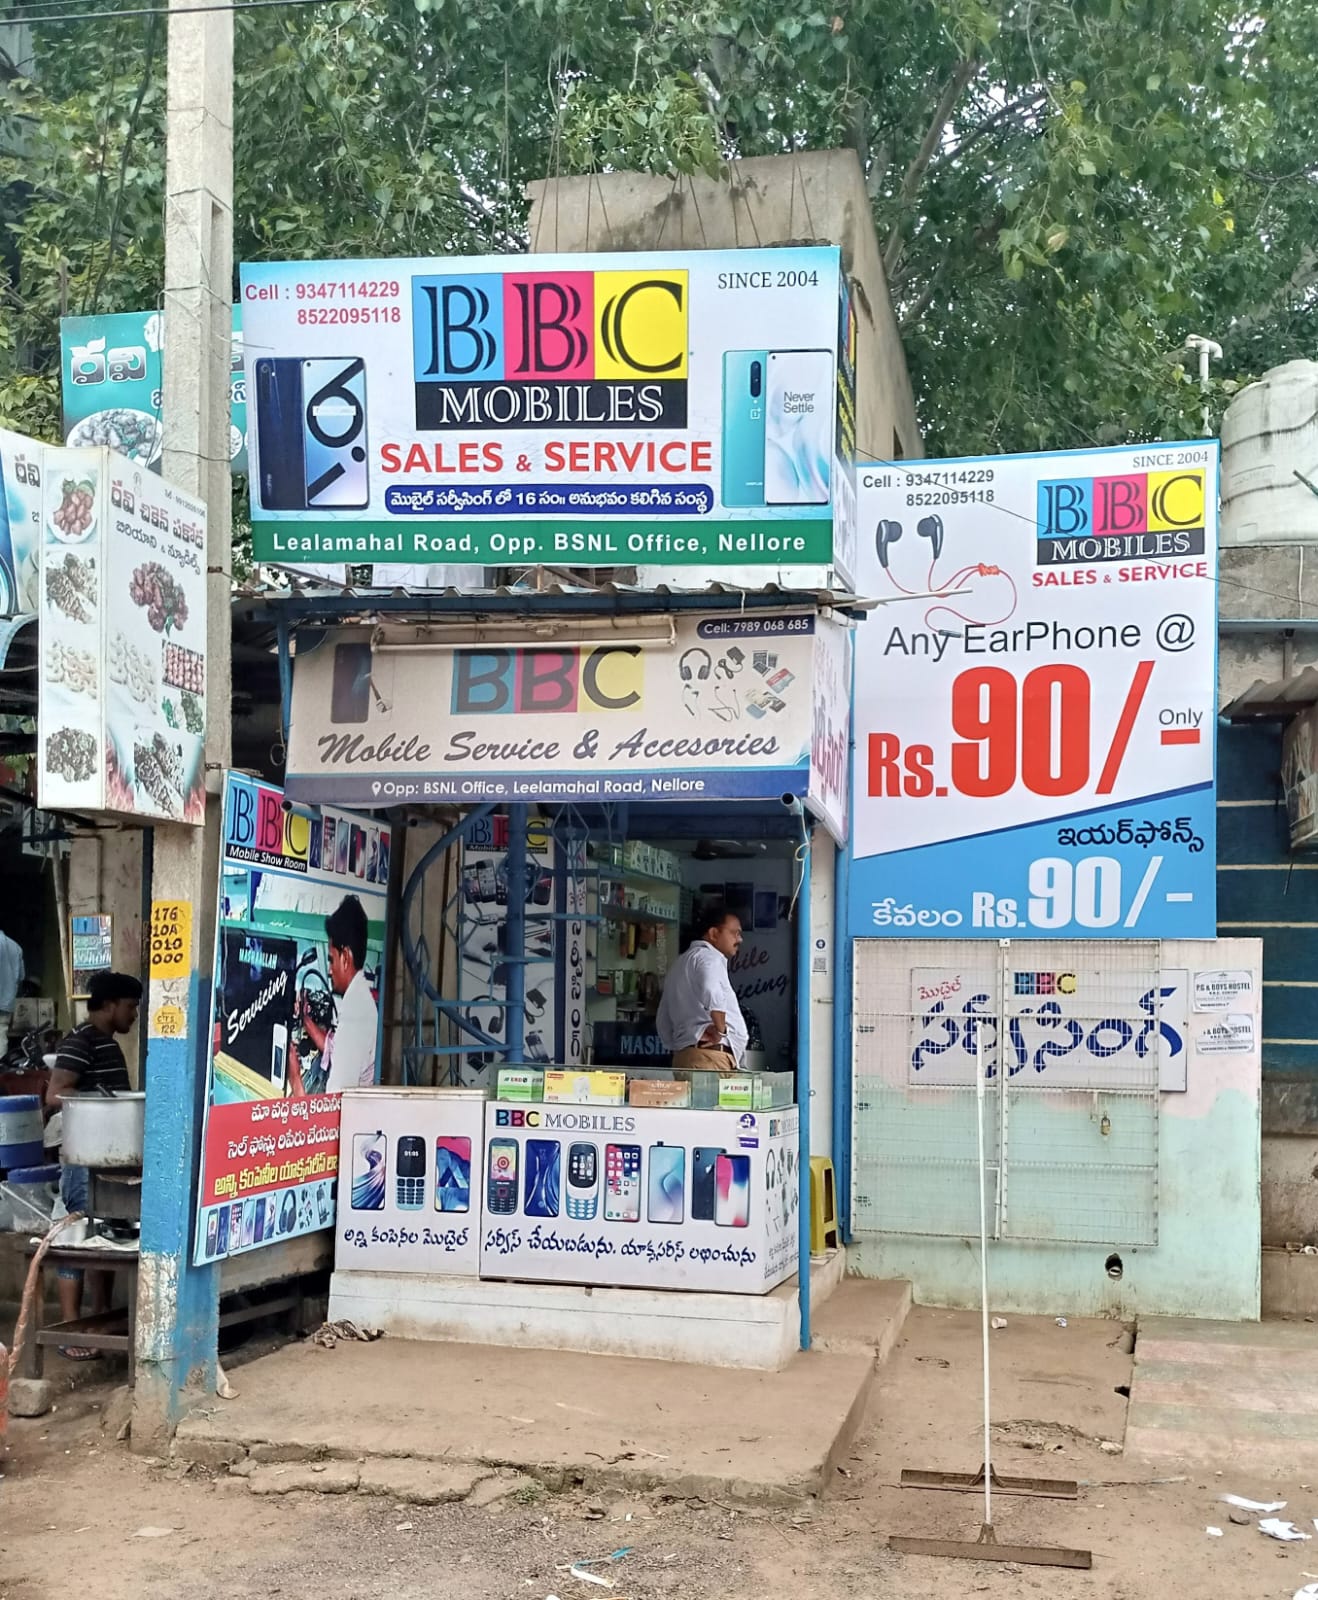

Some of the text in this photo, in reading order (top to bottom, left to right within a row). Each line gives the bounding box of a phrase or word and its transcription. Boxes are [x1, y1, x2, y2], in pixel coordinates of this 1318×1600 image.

[245, 284, 279, 300] Cell
[295, 281, 400, 300] 9347114229
[717, 270, 819, 289] SINCE 2004
[297, 306, 401, 325] 8522095118
[421, 280, 684, 376] BBC
[438, 385, 664, 423] MOBILES
[783, 391, 815, 402] Never
[783, 402, 815, 413] Settle
[381, 441, 713, 473] SALES & SERVICE
[1132, 451, 1209, 468] SINCE 2004
[863, 475, 891, 488] Cell
[905, 469, 995, 487] 9347114229
[390, 490, 434, 511] మొబైల్
[516, 492, 536, 505] 16
[569, 491, 628, 507] అనుభవం
[906, 489, 995, 506] 8522095118
[1043, 474, 1203, 535] BBC
[273, 533, 806, 555] Lealamahal Road, Opp. BSNL Office, Nellore
[1051, 531, 1191, 561] MOBILES
[1032, 562, 1208, 587] SALES & SERVICE
[704, 619, 809, 634] Cell: 7989 068 685
[884, 613, 1197, 662] Any EarPhone @
[455, 645, 642, 713] BBC
[1158, 708, 1203, 728] Only
[318, 727, 780, 764] Mobile Service & Accesories
[383, 778, 705, 797] Opp: BSNL Office, Leelamahal Road, Nellore
[230, 786, 308, 855] BBC
[229, 846, 306, 870] Mobile Show Room
[871, 897, 963, 927] కేవలం
[1014, 972, 1076, 995] BBC
[227, 970, 288, 1045] Servicing
[495, 1109, 636, 1131] BBC MOBILES
